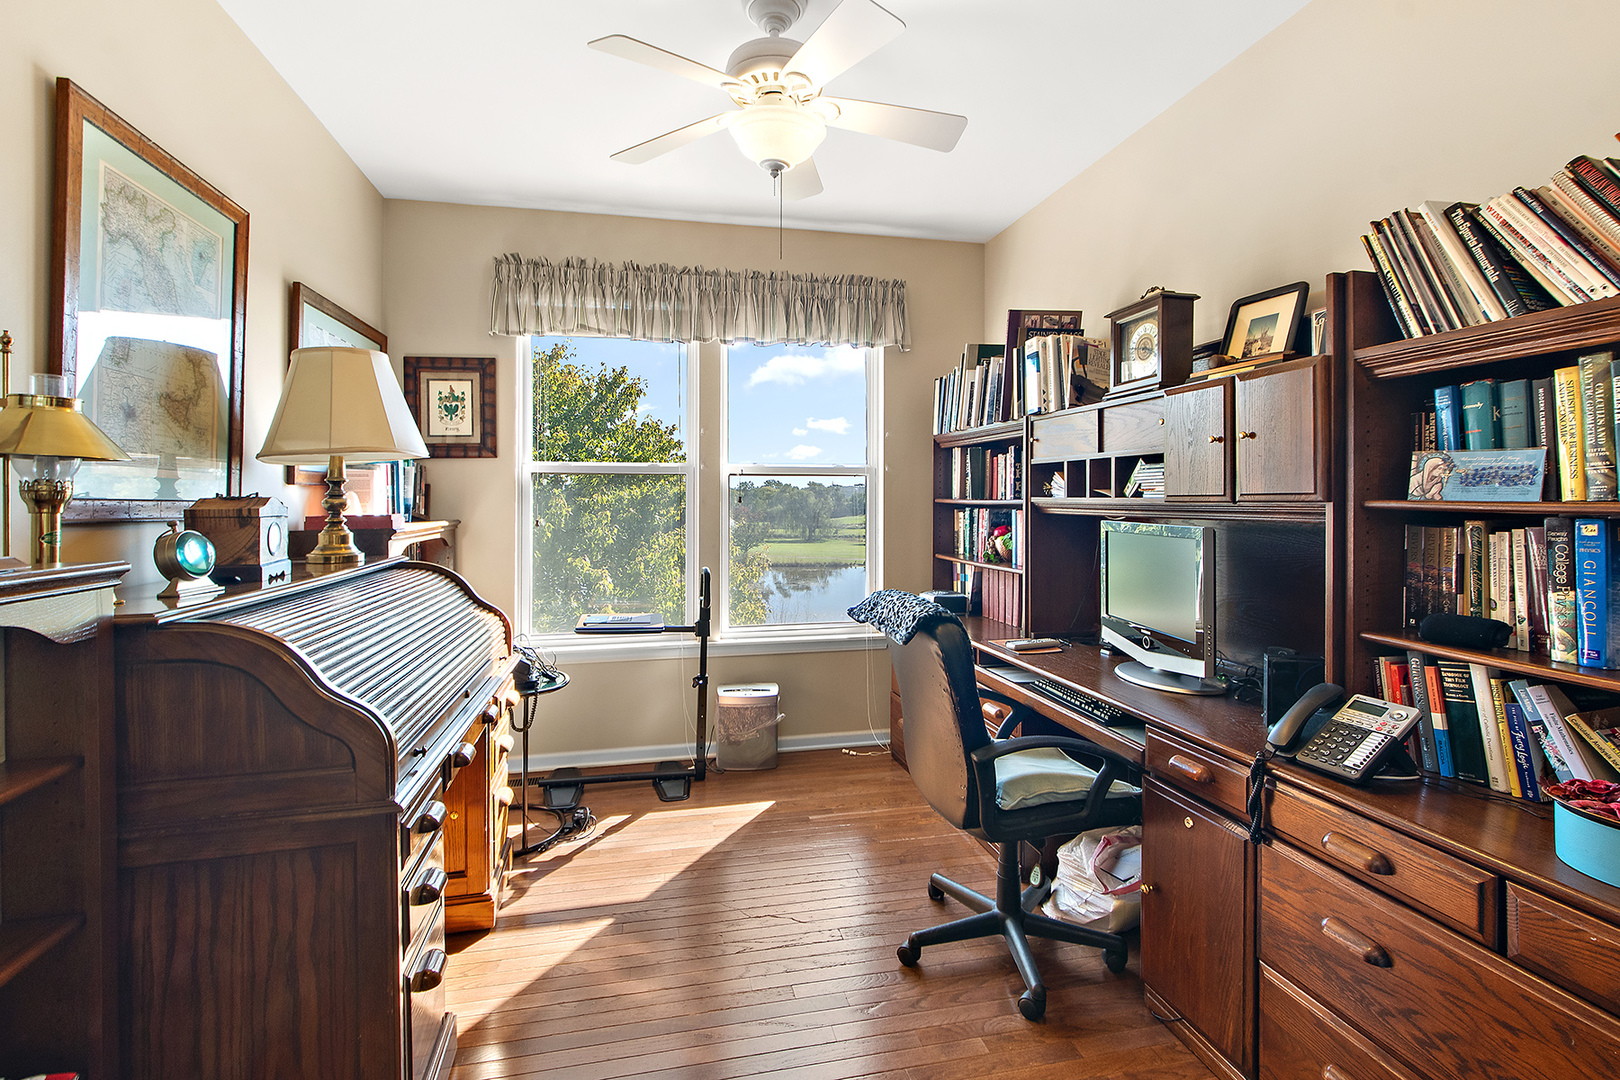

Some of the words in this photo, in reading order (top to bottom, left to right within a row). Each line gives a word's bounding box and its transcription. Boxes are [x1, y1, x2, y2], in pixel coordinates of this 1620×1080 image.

[1450, 209, 1466, 225] The
[1455, 220, 1479, 248] Sports
[1484, 203, 1532, 248] WIMBLEDON
[1470, 242, 1501, 283] Immortals
[1384, 269, 1403, 303] Circuits
[1582, 358, 1593, 398] ANALYTIC
[1536, 387, 1546, 411] MODERN
[1566, 379, 1576, 422] STATISTICS
[1594, 382, 1605, 422] CALCULUS
[1537, 411, 1547, 445] ELEMENTARY
[1567, 423, 1576, 438] FOR
[1584, 399, 1595, 444] GEOMETRY
[1596, 423, 1606, 444] AND
[1568, 439, 1578, 479] BUSINESS
[1411, 531, 1419, 561] RIVERS
[1427, 532, 1435, 562] RIVERS
[1550, 543, 1571, 584] College
[1554, 584, 1573, 628] Physics
[1583, 559, 1596, 635] GIANCOLI
[1410, 657, 1424, 705] GUINNESS
[1494, 702, 1505, 724] TRIVIA
[1486, 736, 1494, 761] Devotions
[1510, 728, 1526, 752] Furry
[1548, 711, 1560, 726] Finite
[1555, 724, 1575, 756] Mathematics
[1570, 717, 1594, 741] Calculator
[1591, 738, 1613, 761] Analysis
[1515, 749, 1530, 770] Logic
